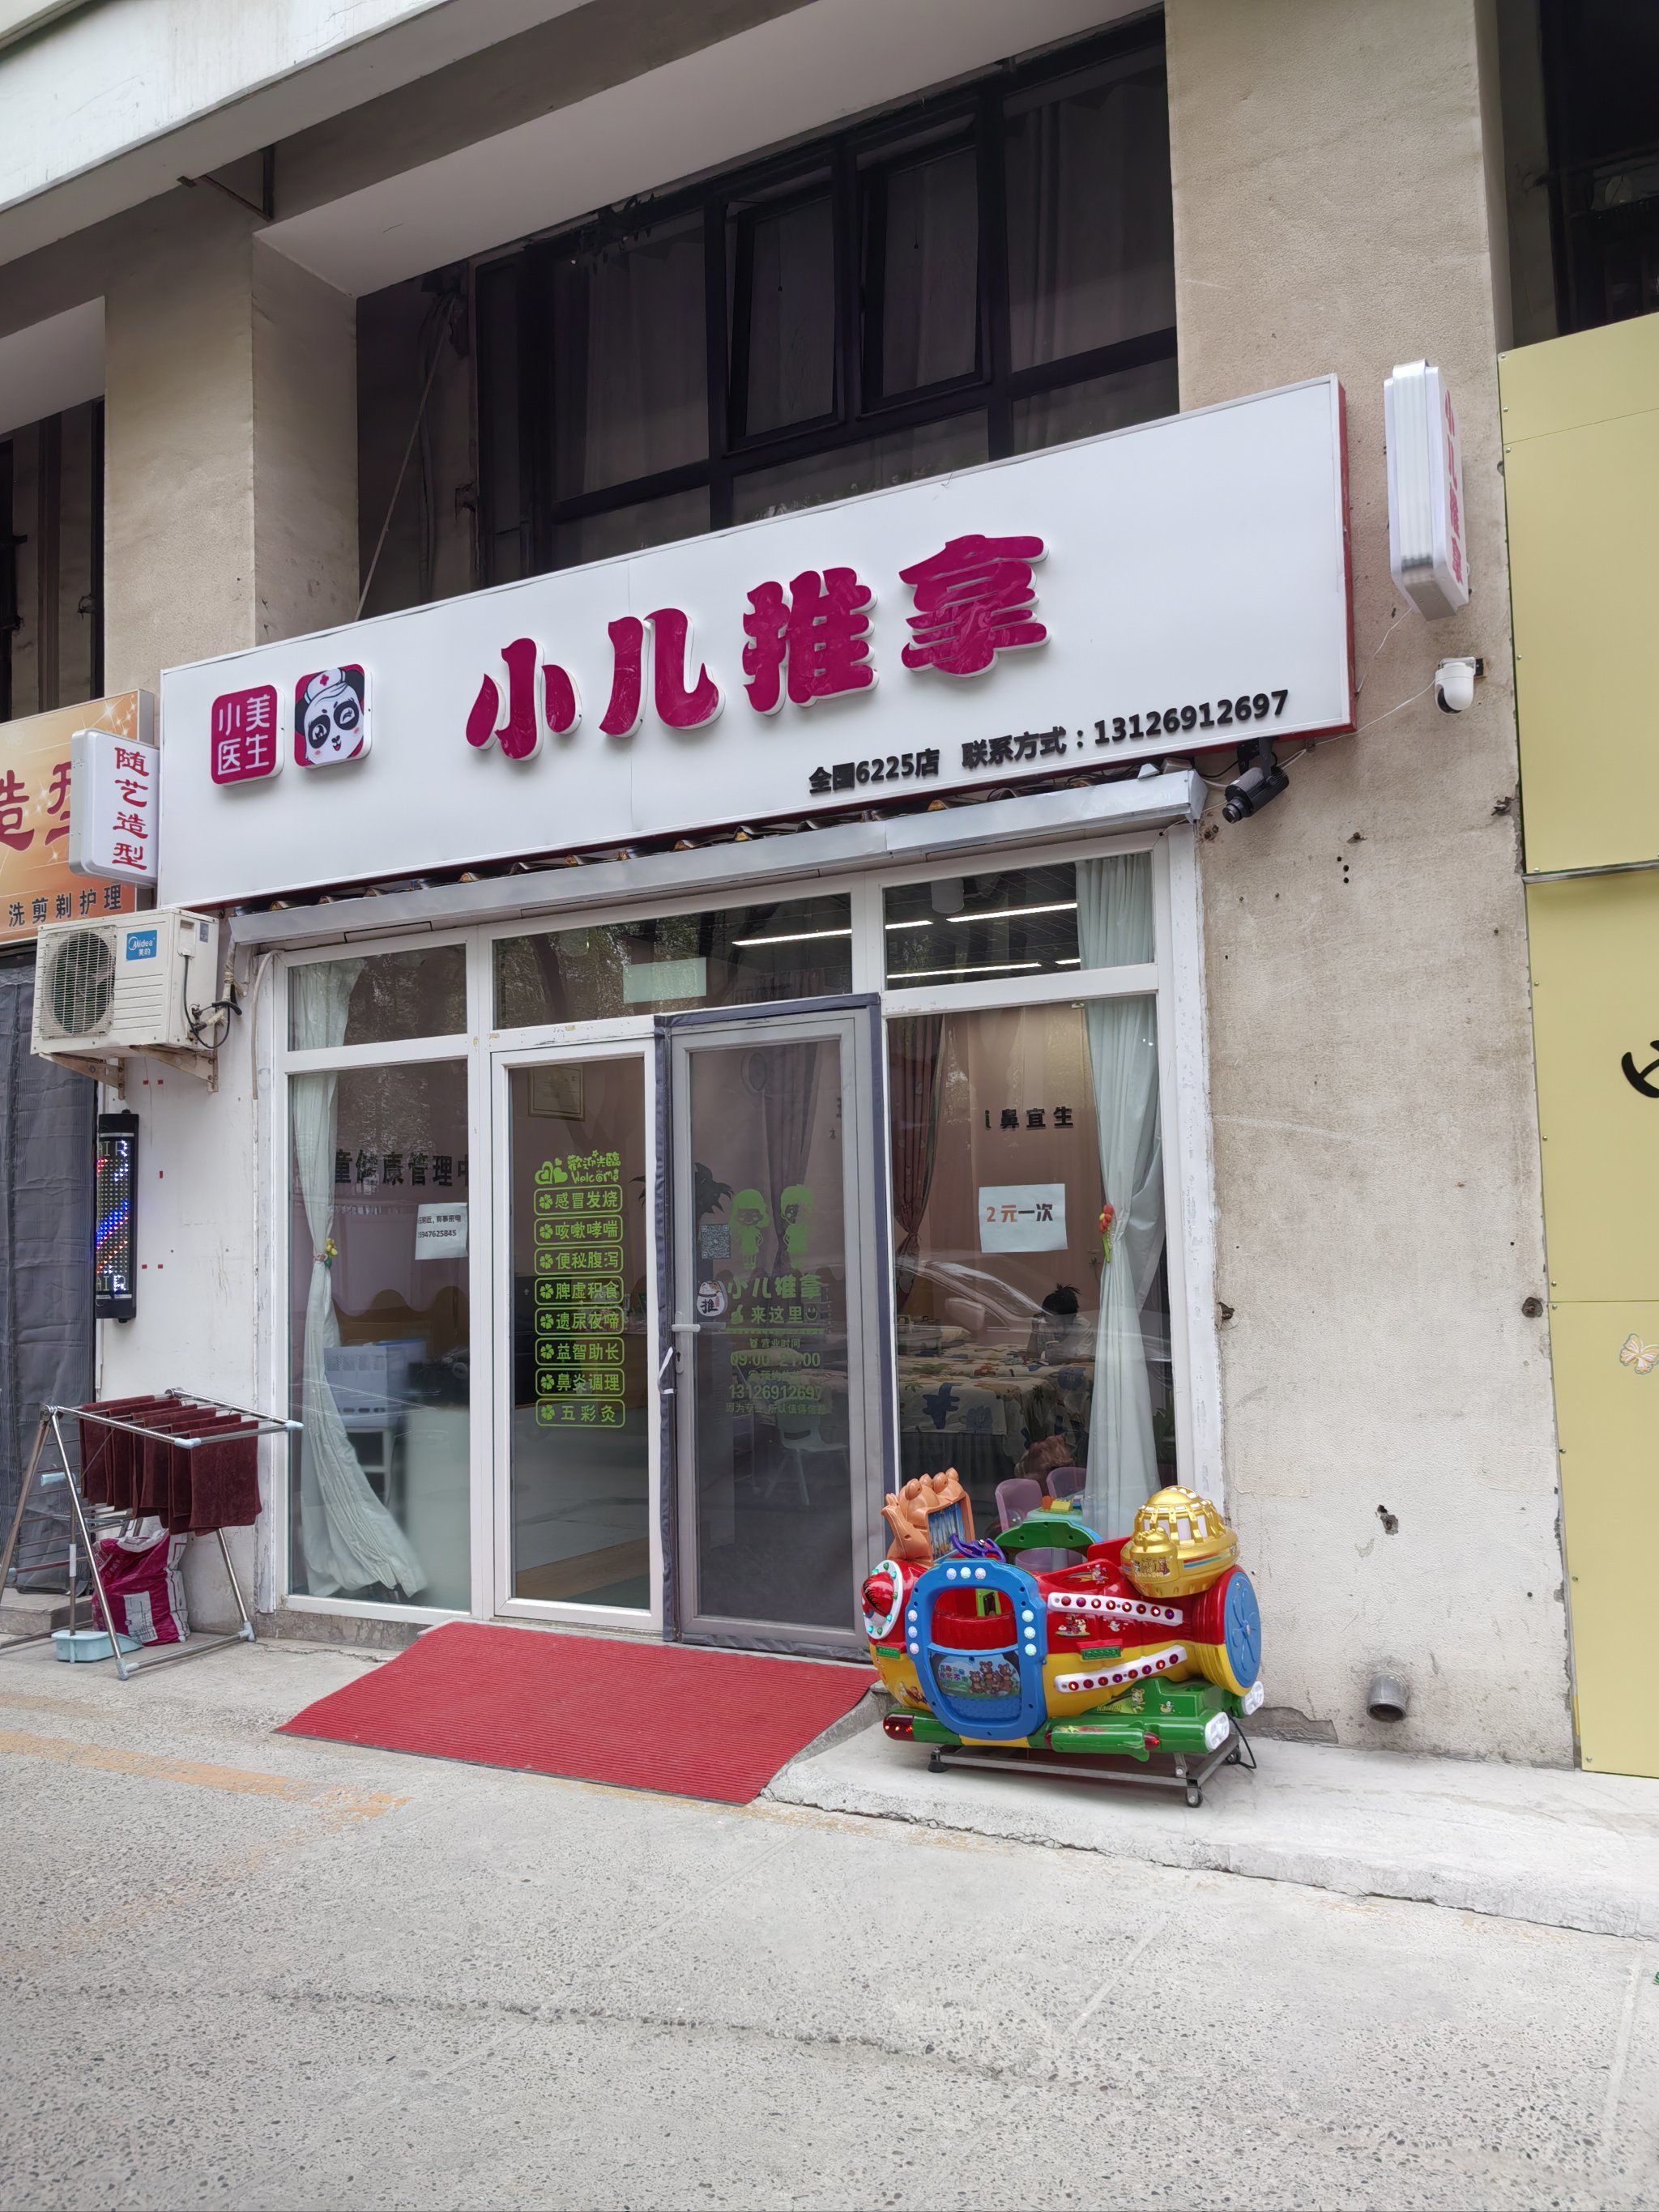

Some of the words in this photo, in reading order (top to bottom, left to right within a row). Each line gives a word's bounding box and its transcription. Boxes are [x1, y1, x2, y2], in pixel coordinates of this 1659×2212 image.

[466, 534, 1051, 761] 小儿推拿
[218, 694, 271, 736] 小美
[217, 734, 270, 775] 医生
[808, 747, 940, 795] 全国6225店
[112, 746, 150, 871] 随艺造型
[8, 884, 122, 927] 洗剪剃护理
[128, 936, 154, 951] Midea
[139, 948, 151, 956] 美的
[570, 1169, 620, 1184] Welcome
[555, 1190, 618, 1210] 感冒发烧
[986, 1203, 1054, 1223] 2元一次
[555, 1220, 618, 1240] 咳嗽哮喘
[556, 1251, 619, 1270] 便秘腹泻
[556, 1281, 620, 1300] 脾虚积食
[727, 1272, 821, 1299] 小儿推拿
[699, 1298, 719, 1314] 推
[751, 1306, 804, 1324] 来这里
[556, 1311, 620, 1330] 遗尿夜啼
[557, 1343, 620, 1361] 益智助长
[557, 1373, 621, 1391] 鼻炎调理
[728, 1384, 823, 1400] 13126912697
[561, 1404, 616, 1422] 五彩灸
